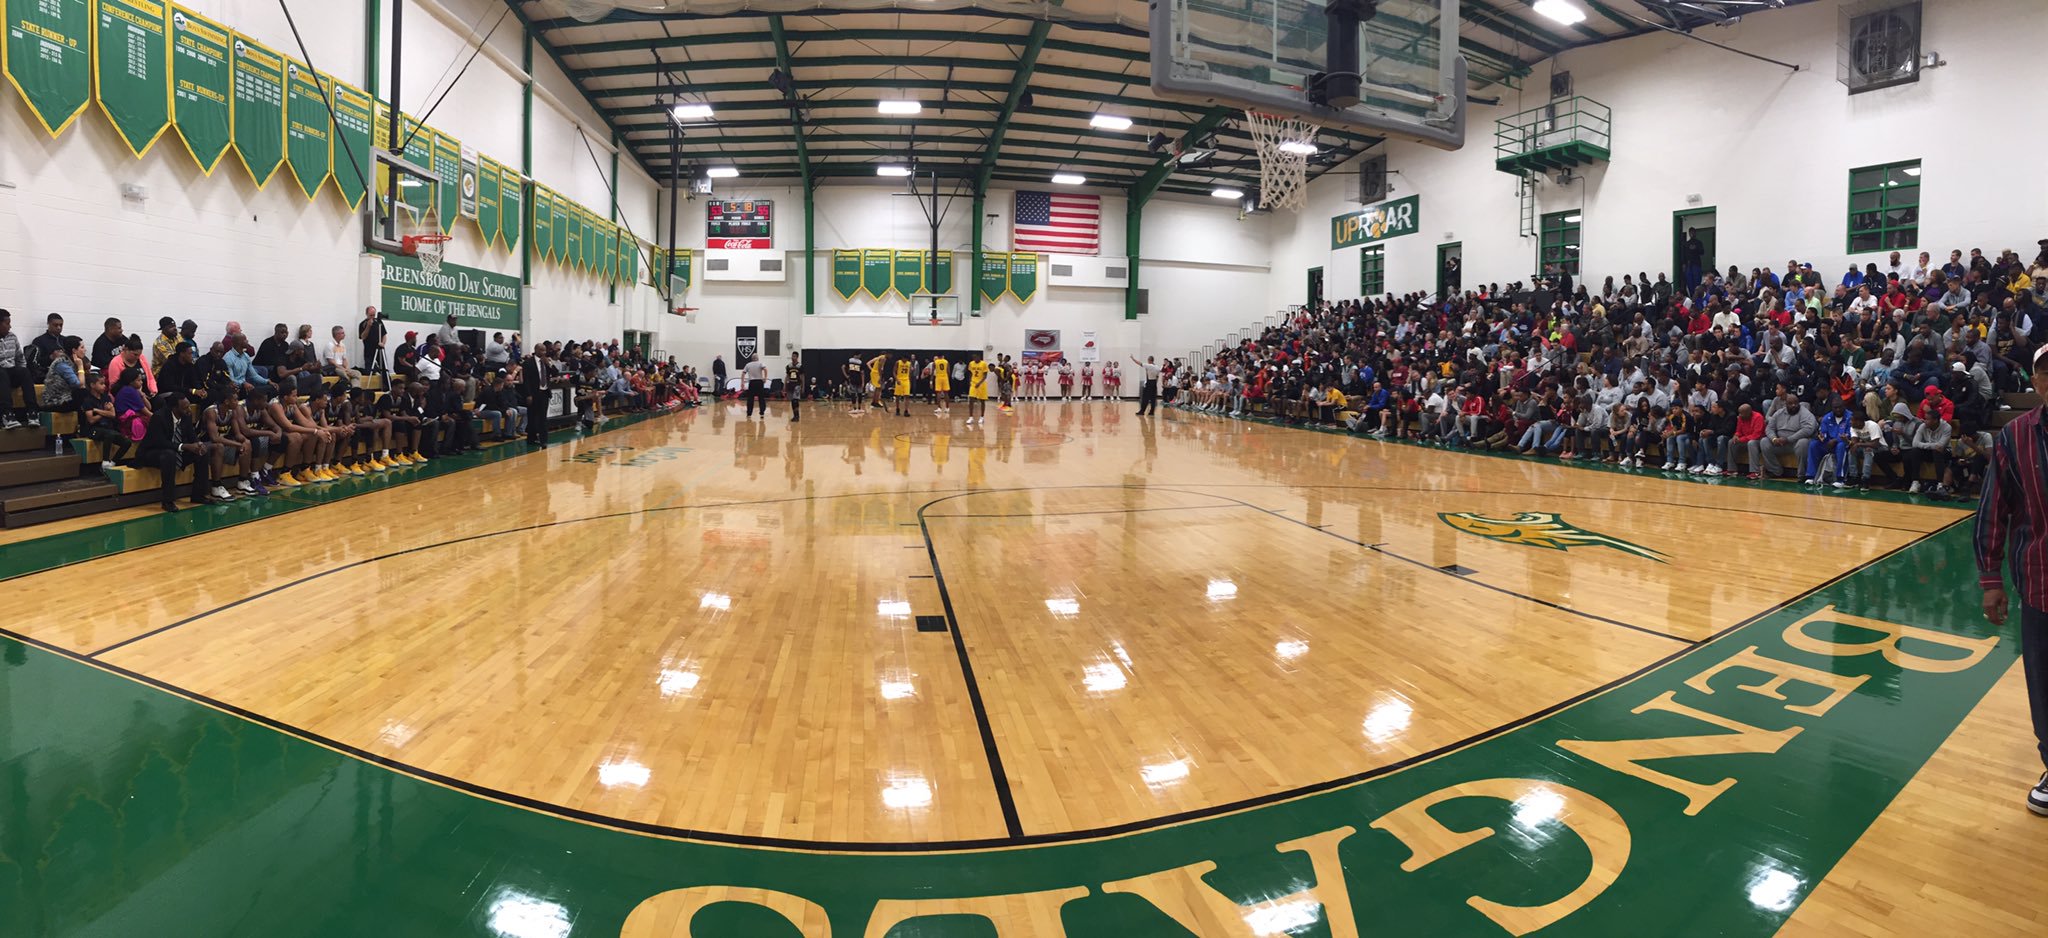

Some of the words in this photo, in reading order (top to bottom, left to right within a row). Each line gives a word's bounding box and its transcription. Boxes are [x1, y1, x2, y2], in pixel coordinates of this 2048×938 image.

[180, 35, 195, 48] STATE
[180, 79, 194, 91] STATE
[401, 295, 432, 313] HOME
[434, 299, 446, 314] OF
[448, 302, 465, 317] THE
[467, 304, 500, 320] BENGALS
[619, 604, 2000, 938] BENGA
